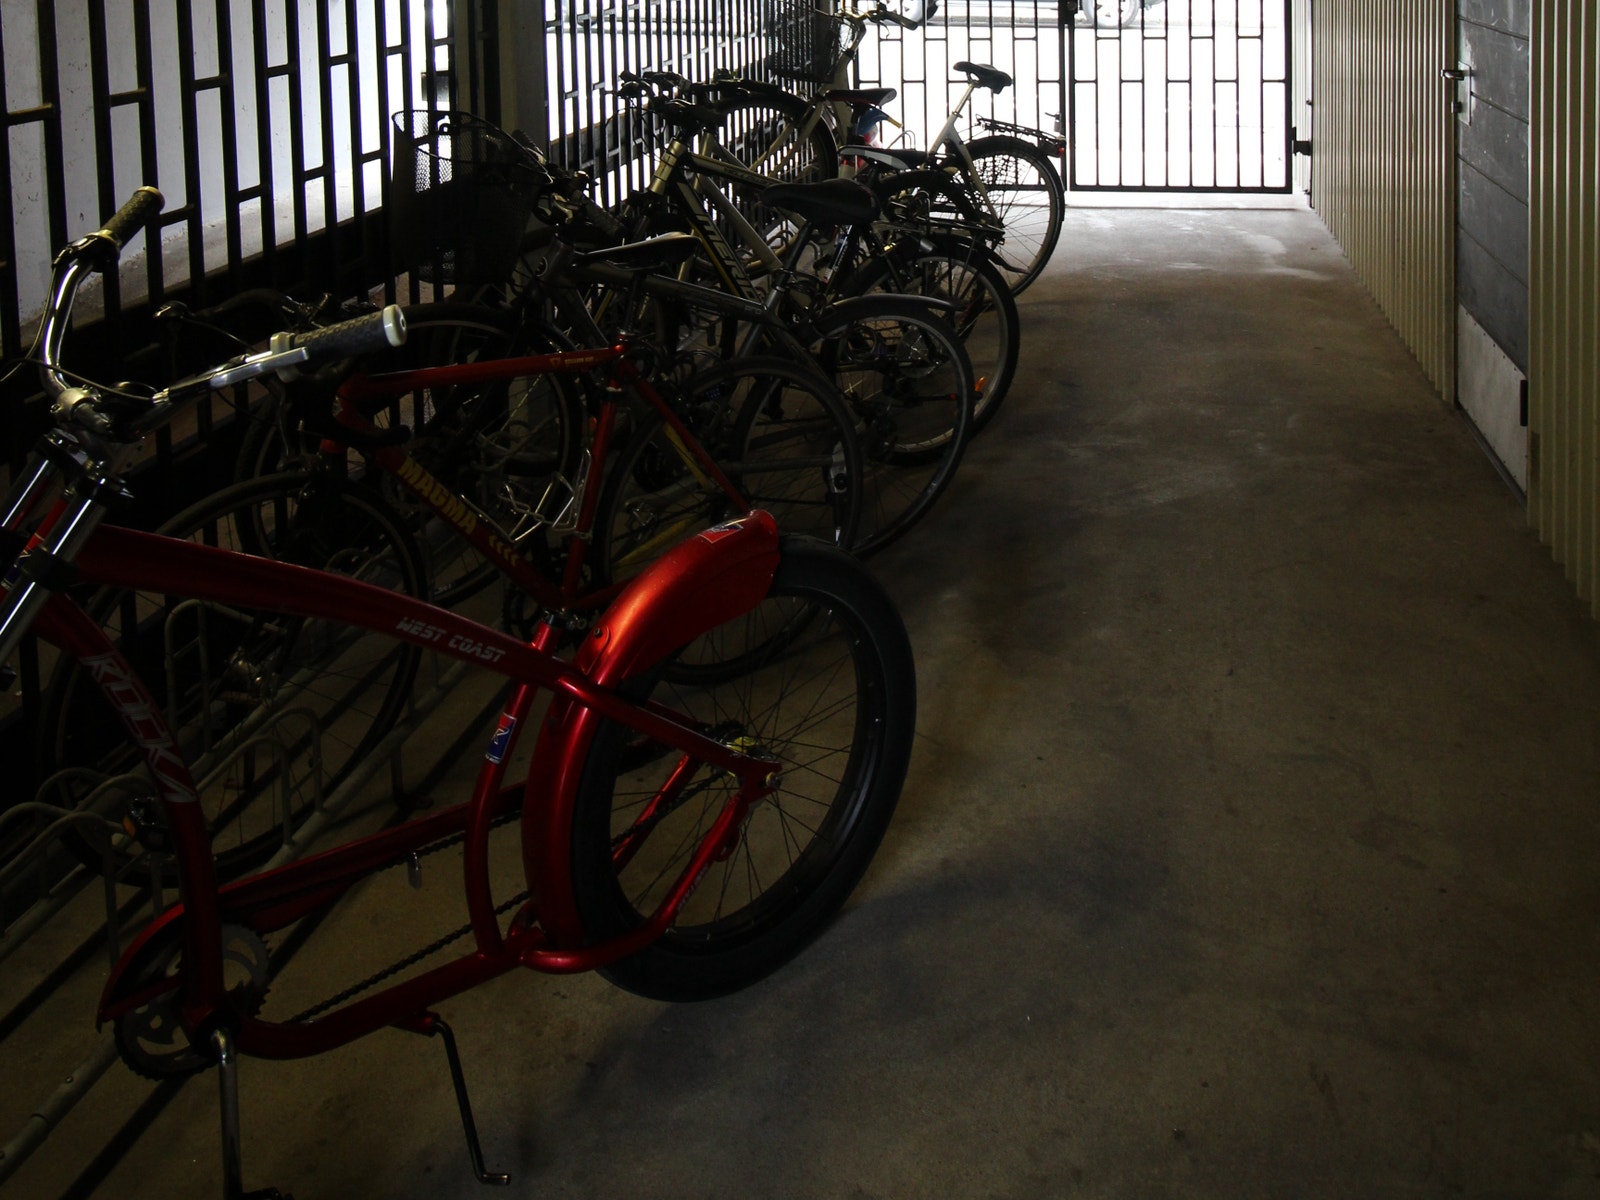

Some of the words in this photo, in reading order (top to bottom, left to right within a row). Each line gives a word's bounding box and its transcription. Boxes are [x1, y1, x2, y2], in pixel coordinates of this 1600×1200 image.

[695, 214, 761, 304] MERID
[398, 456, 478, 535] MAGMA
[395, 616, 448, 642] WEST
[447, 634, 506, 662] COAST
